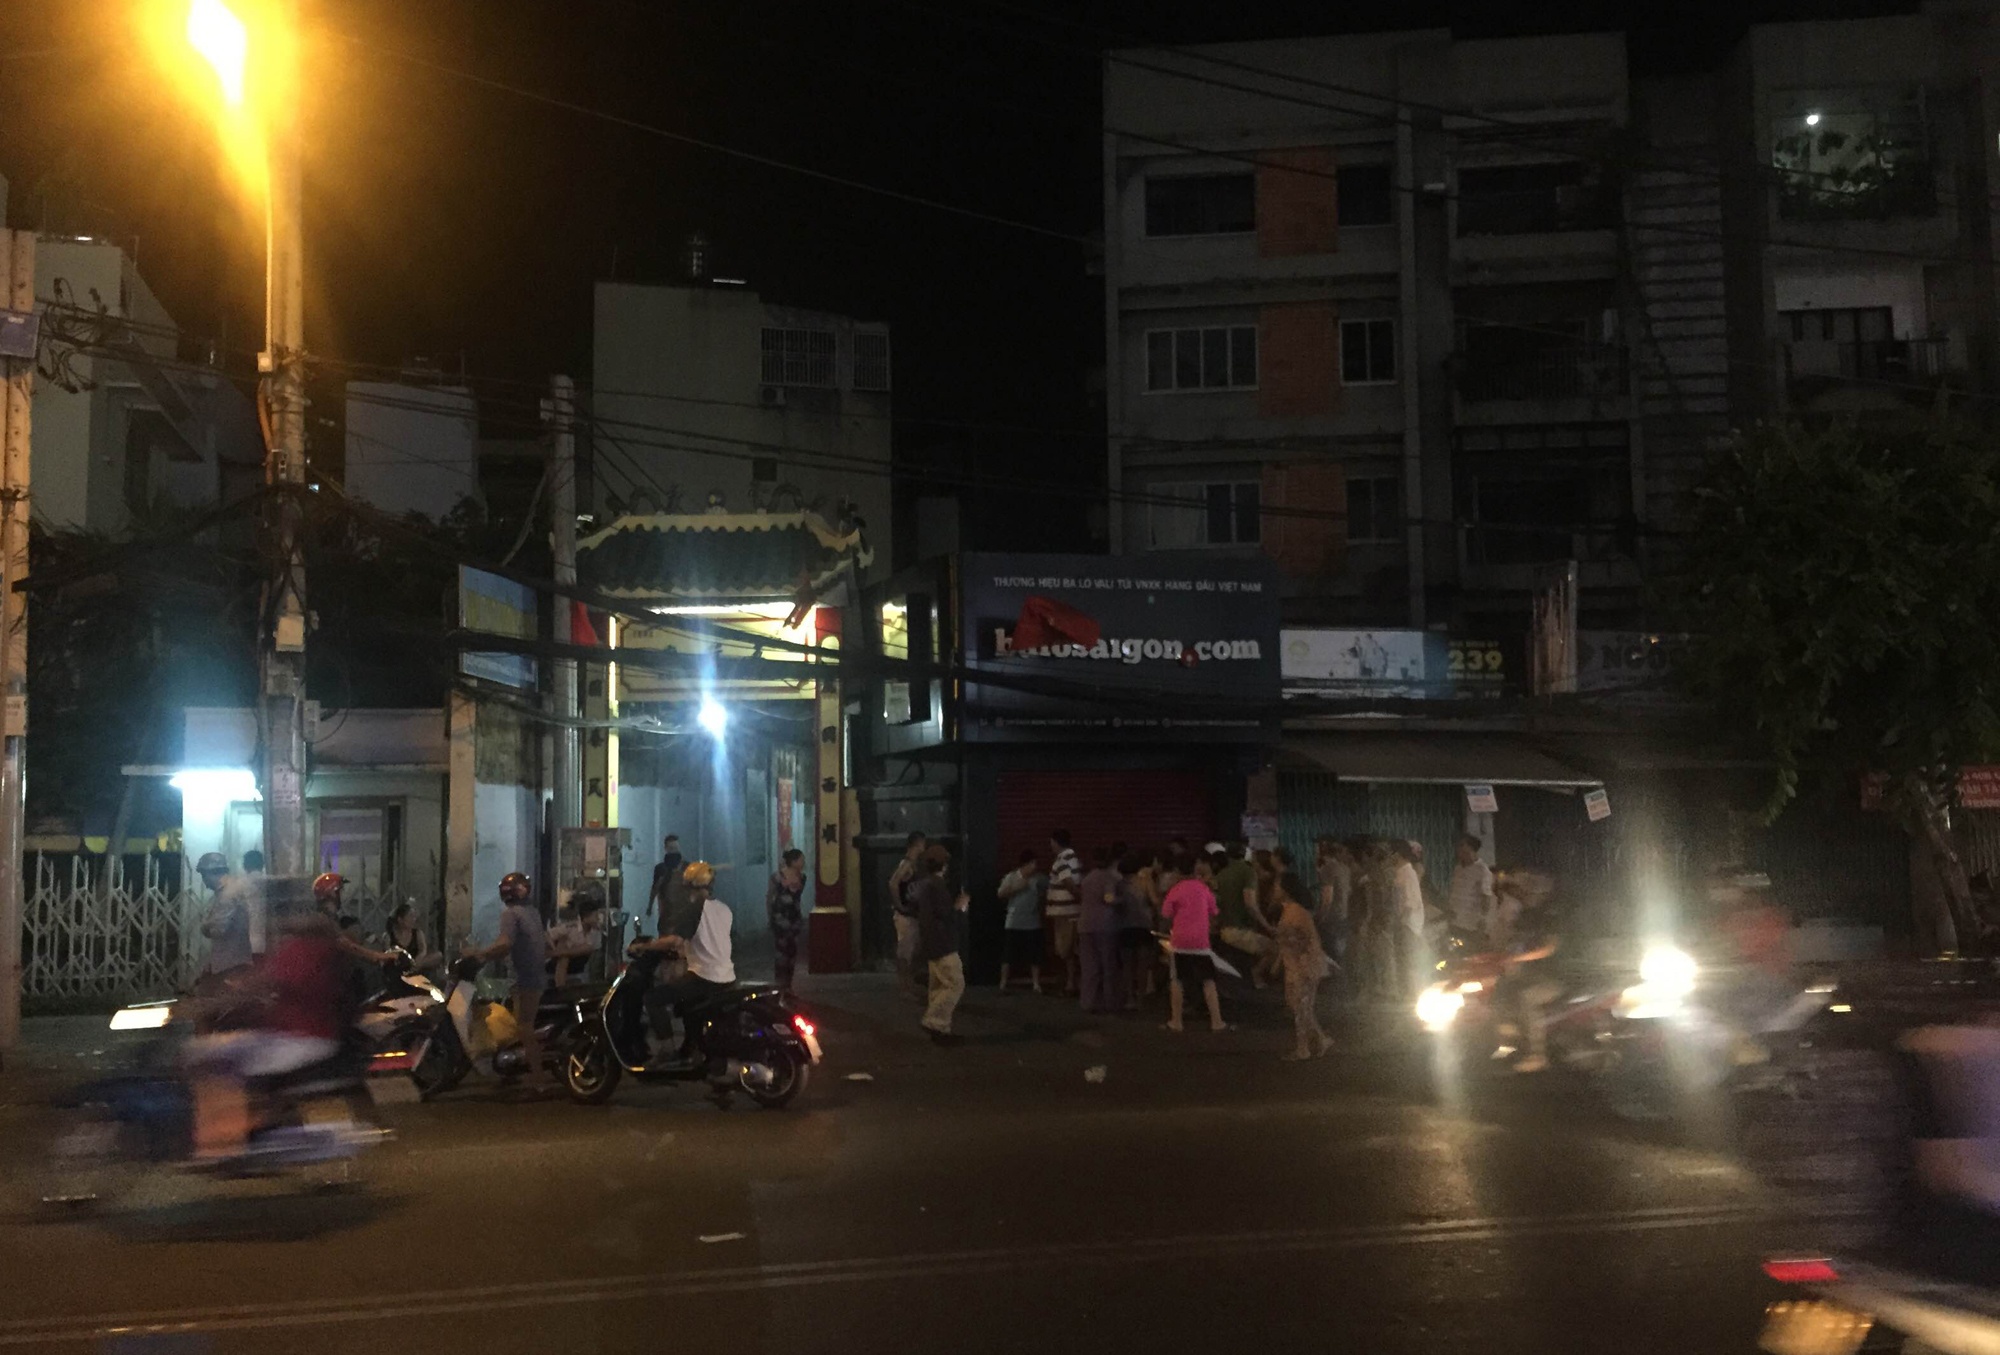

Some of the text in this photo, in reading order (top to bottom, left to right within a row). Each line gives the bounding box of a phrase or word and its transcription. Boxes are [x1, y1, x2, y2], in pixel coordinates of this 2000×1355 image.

[1062, 578, 1077, 589] BA
[1241, 581, 1262, 592] NAM
[1448, 650, 1503, 672] 239
